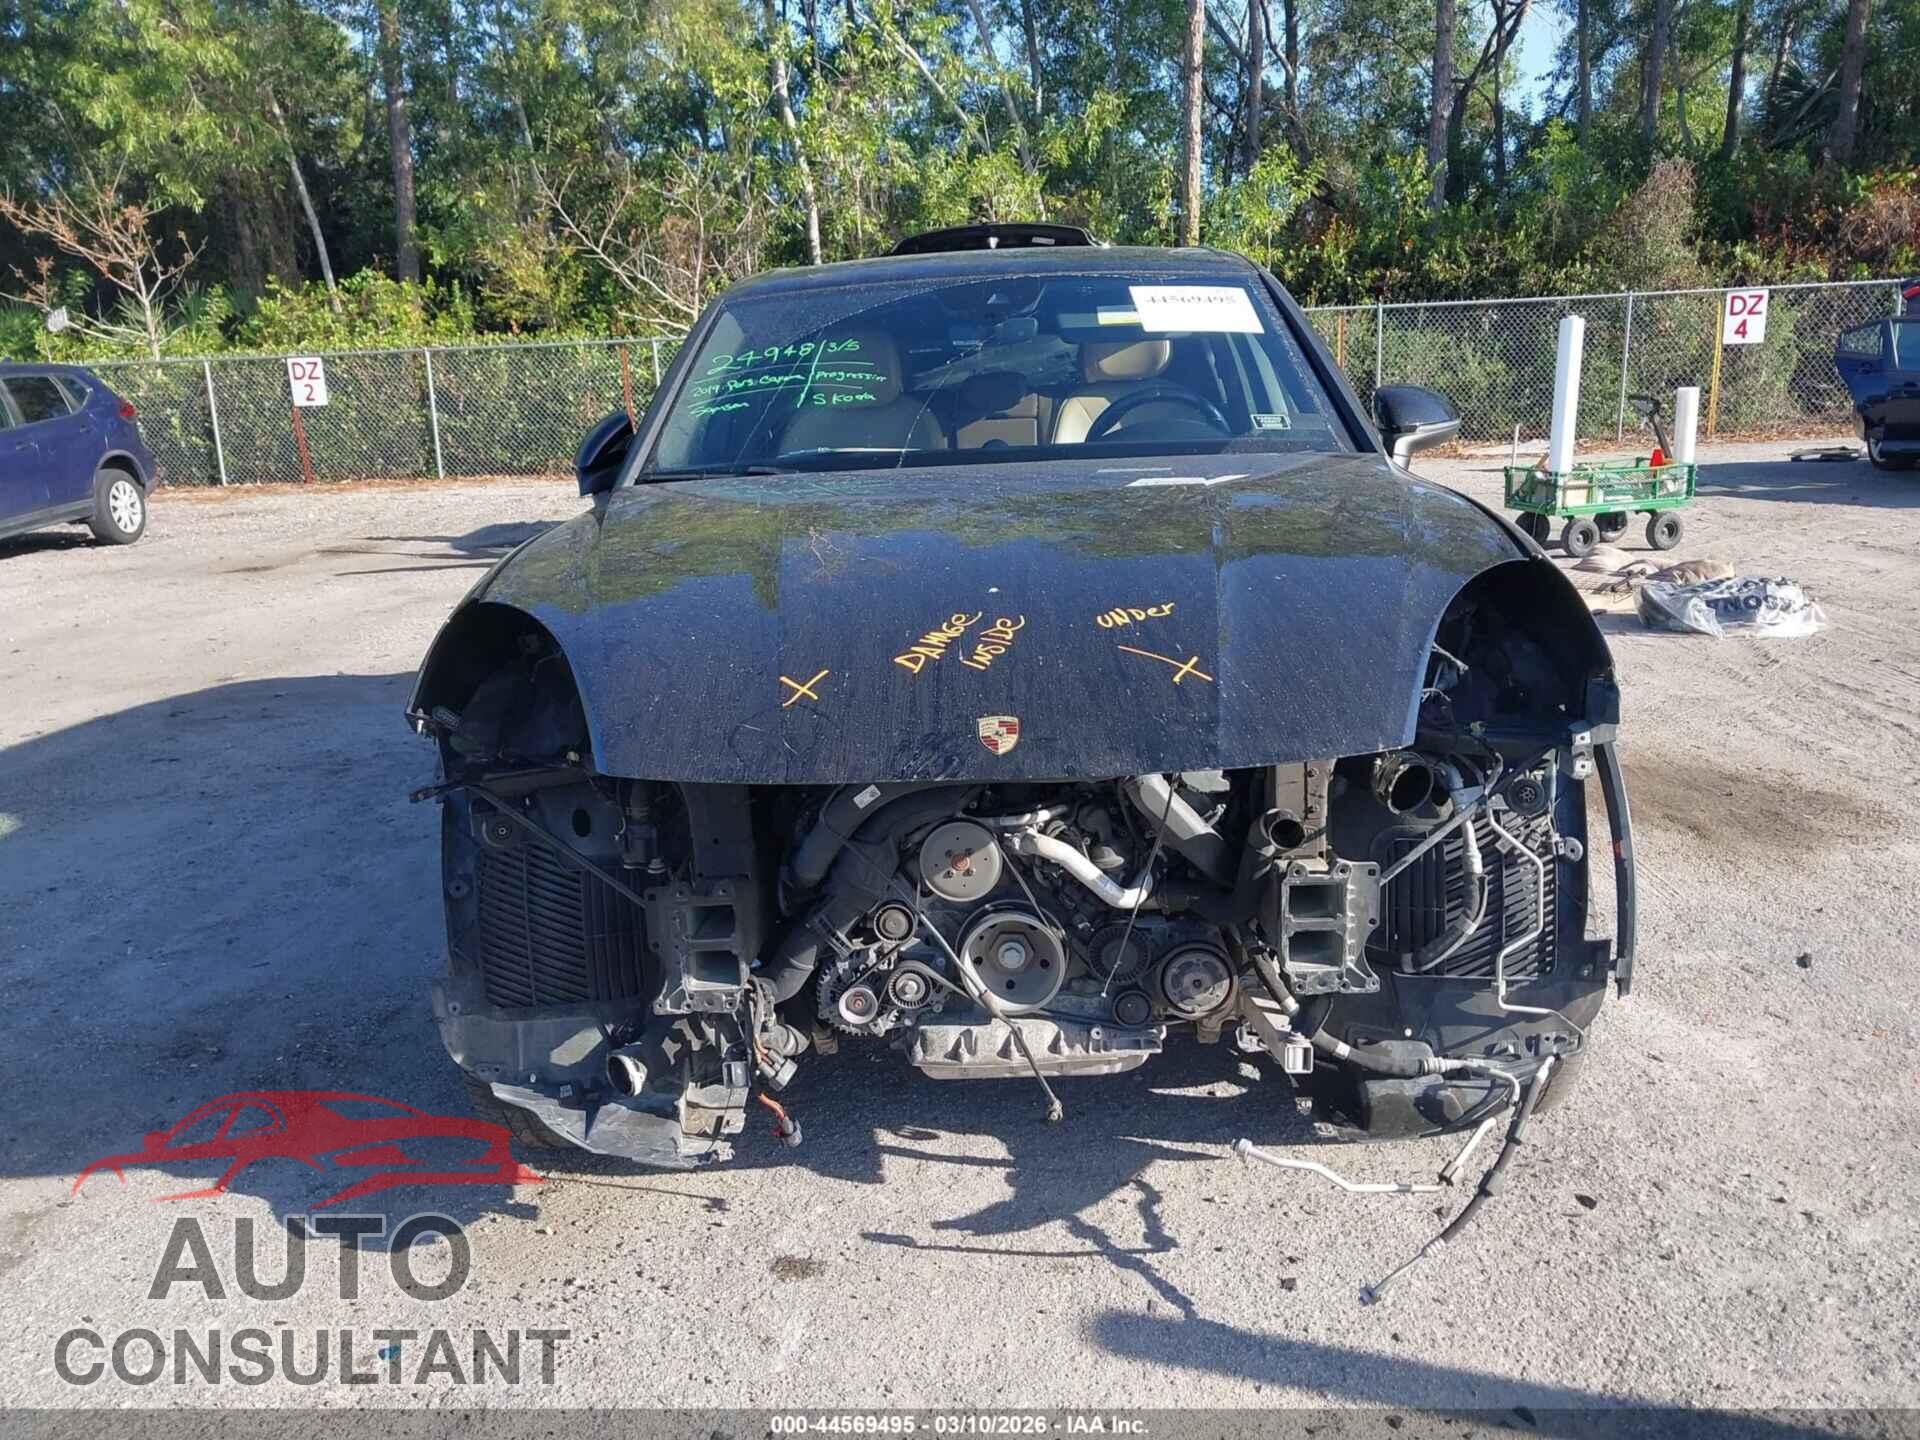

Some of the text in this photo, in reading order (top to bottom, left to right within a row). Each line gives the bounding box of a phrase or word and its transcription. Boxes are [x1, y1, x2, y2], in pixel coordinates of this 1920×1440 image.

[1729, 295, 1764, 316] DZ
[1734, 318, 1748, 339] 4
[291, 361, 321, 380] DZ
[304, 383, 316, 401] 2
